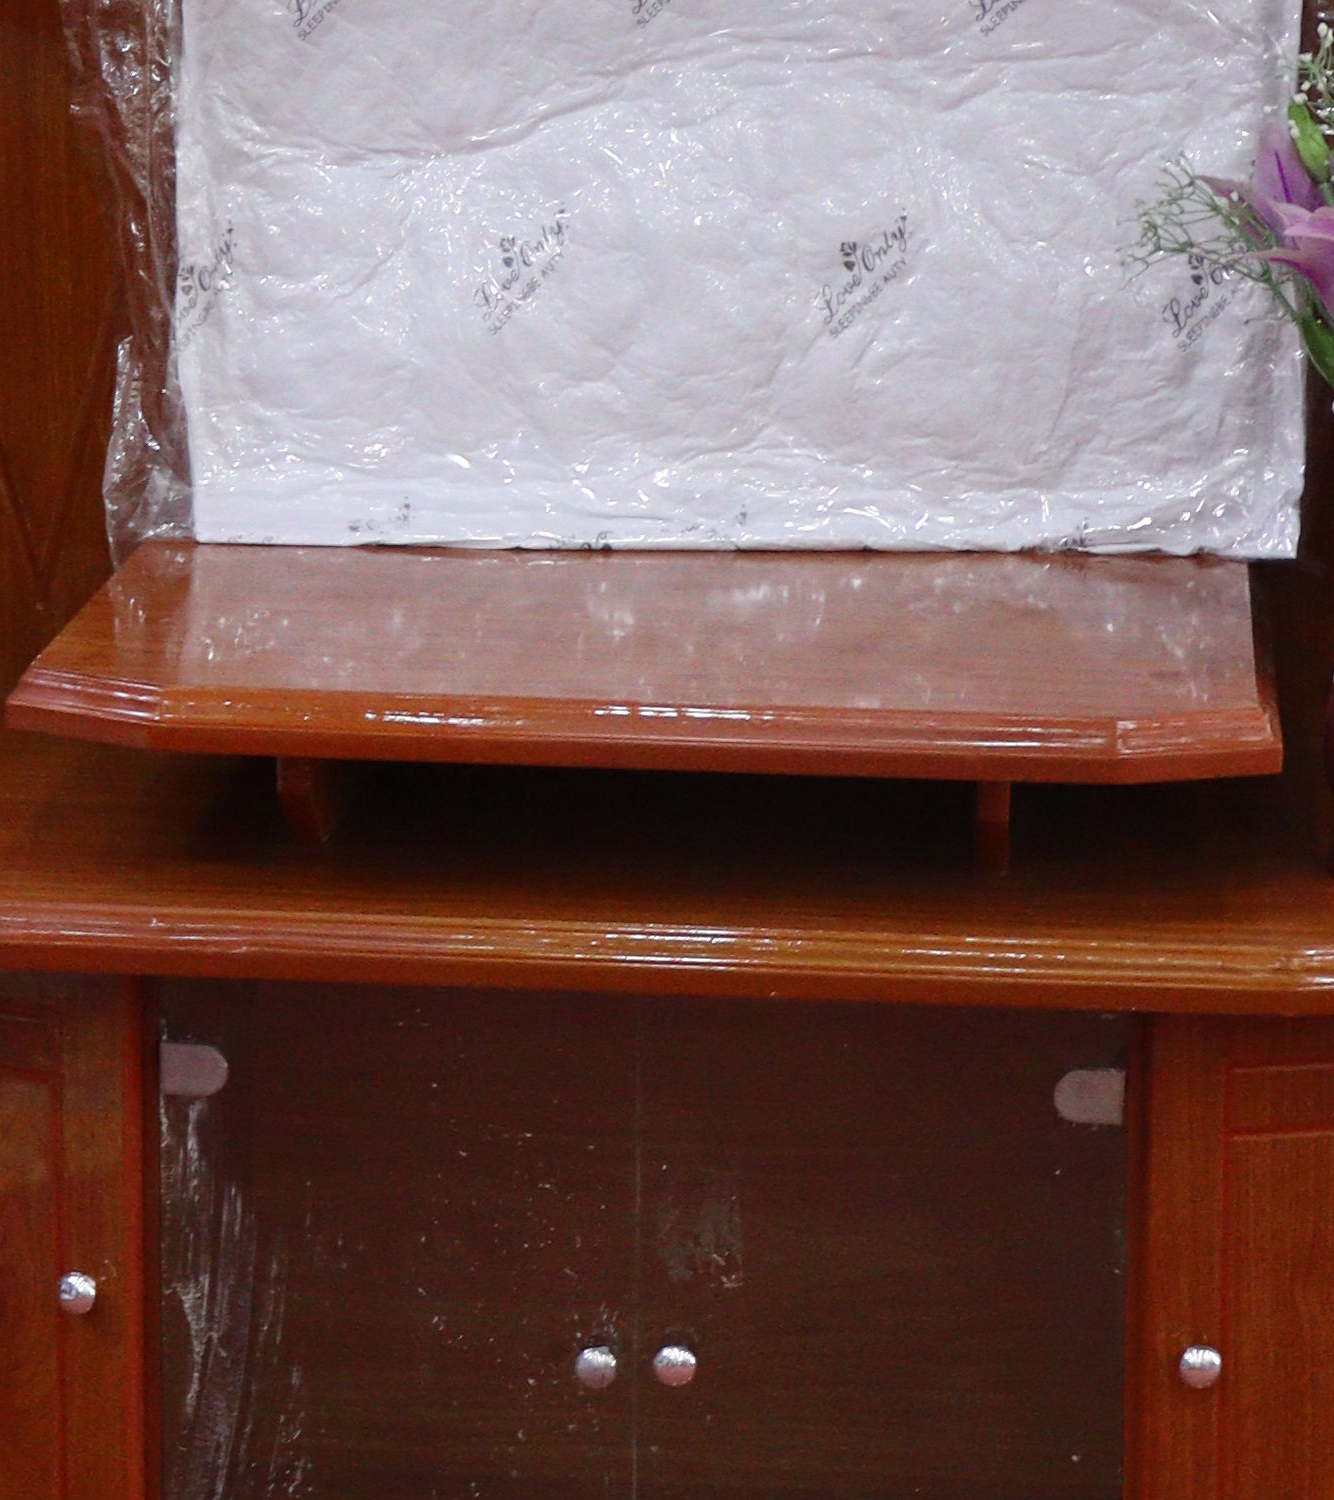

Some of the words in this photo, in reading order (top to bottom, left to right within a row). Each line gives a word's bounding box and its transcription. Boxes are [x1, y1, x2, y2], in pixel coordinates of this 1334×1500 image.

[814, 272, 862, 325] Love
[862, 224, 907, 272] Only
[1162, 285, 1209, 338] Love
